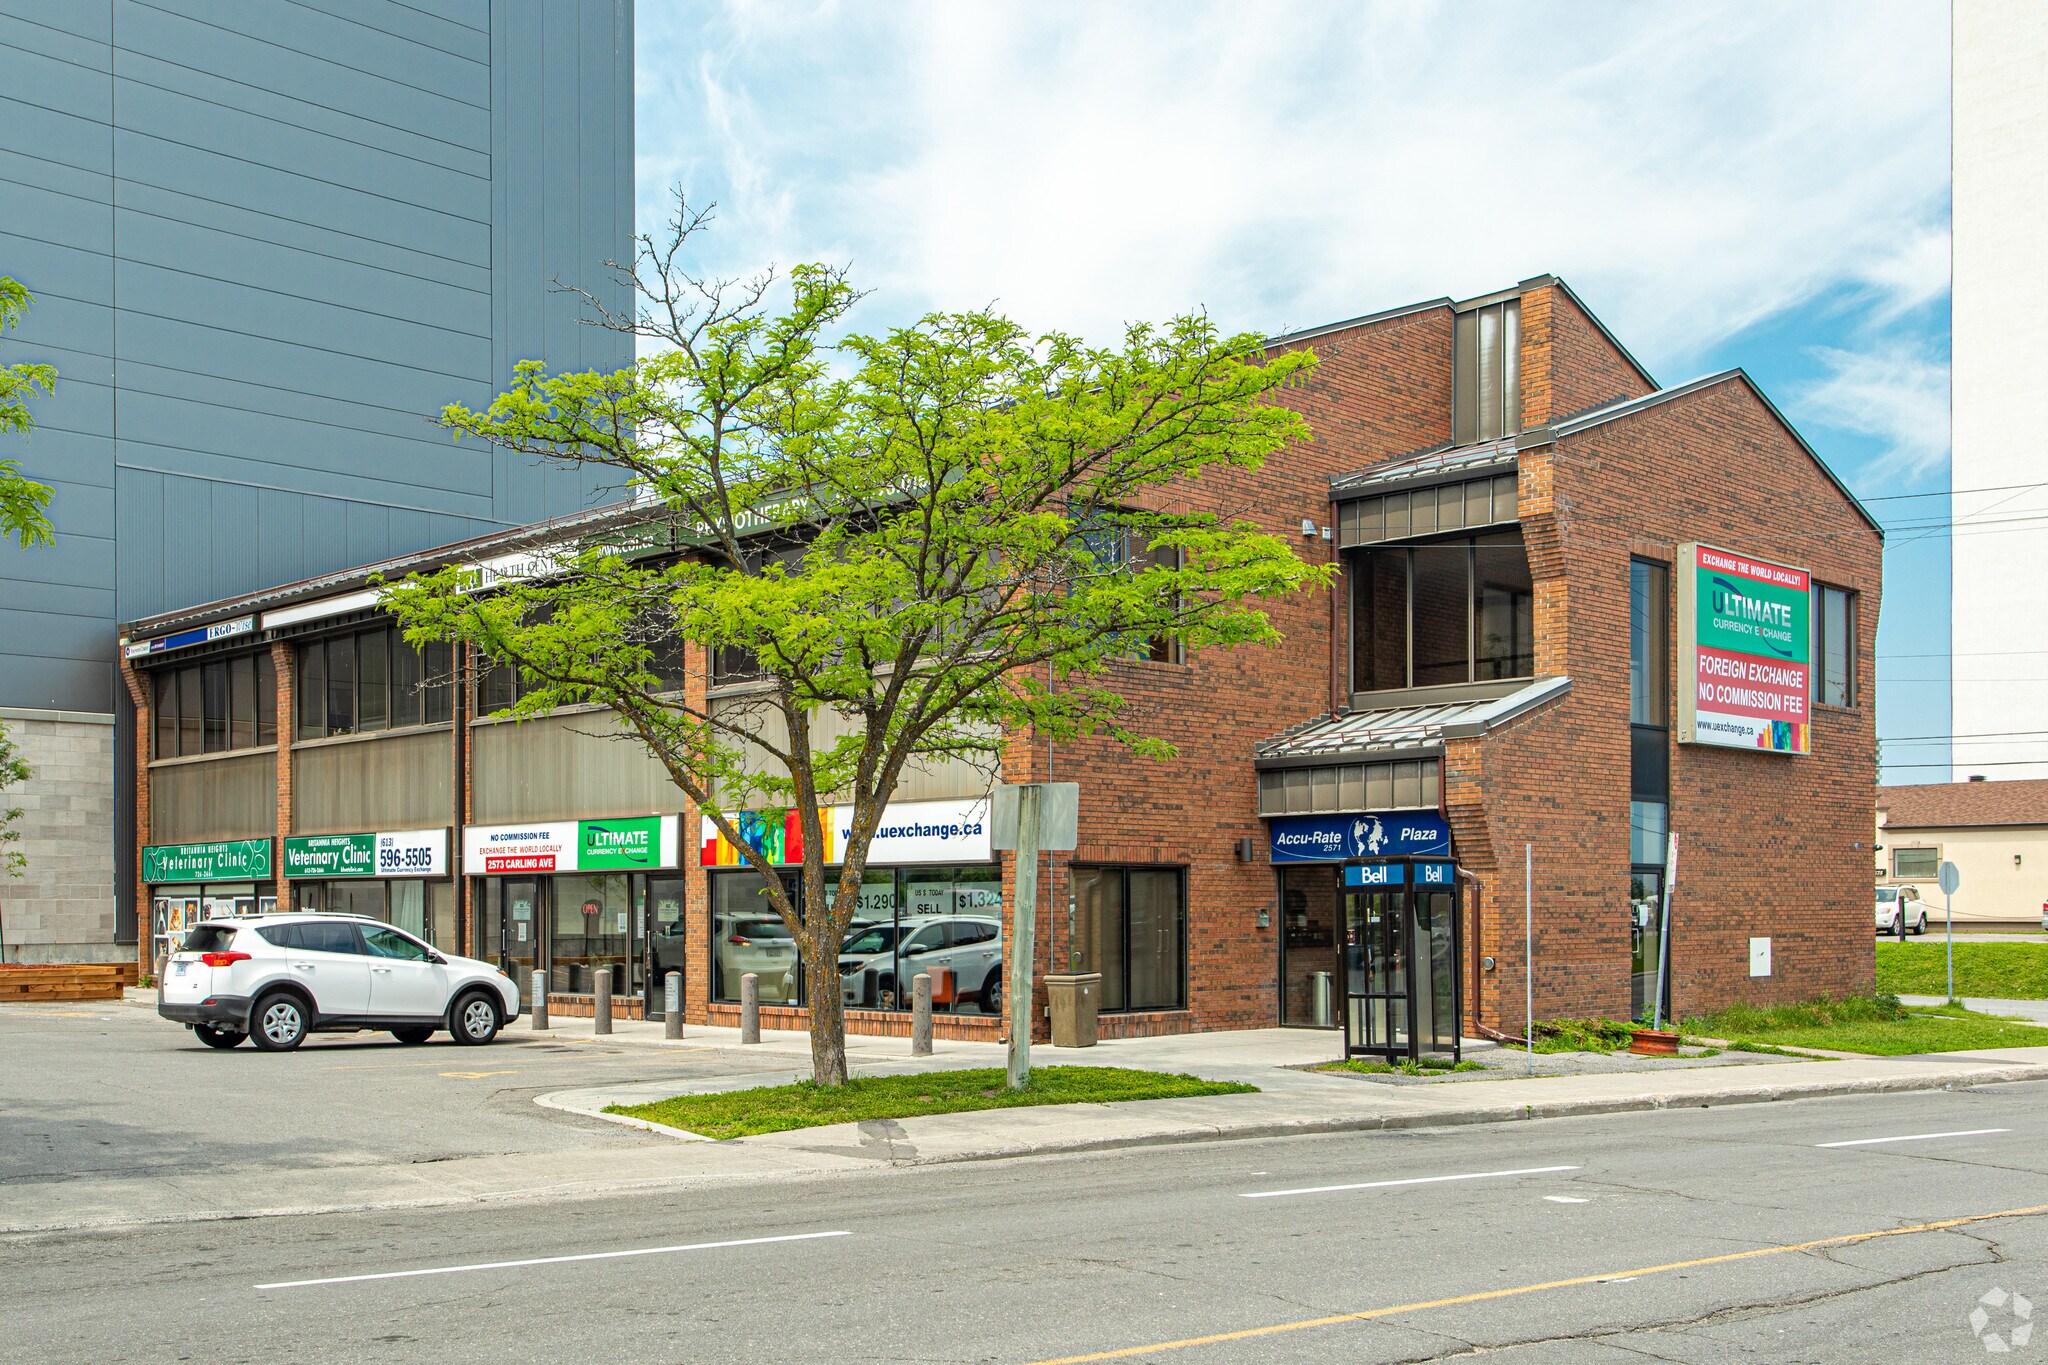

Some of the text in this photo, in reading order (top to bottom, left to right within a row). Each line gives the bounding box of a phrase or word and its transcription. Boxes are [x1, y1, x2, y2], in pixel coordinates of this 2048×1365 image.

[1702, 553, 1800, 586] EXCHANGE THE WORLD LOCALLY!
[1712, 590, 1792, 627] ULTIMATE
[1713, 617, 1792, 642] CURRENCY EXCHANGE
[1699, 655, 1803, 689] FOREIGN EXCHANGE
[1699, 681, 1803, 714] NO COMMISSION FEE
[1697, 720, 1754, 736] www.uexchange.ca
[490, 831, 550, 842] NO COMMISSION FEE
[587, 829, 649, 846] ULTIMATE
[842, 822, 983, 840] w.uexchange.ca
[1277, 828, 1438, 845] Accu-Rate Plaza
[180, 844, 228, 856] BRITANNIA HEIGHTS
[308, 837, 351, 847] BRITANNIA HEIGHTS
[380, 837, 394, 848] (613)
[479, 844, 562, 855] EXCHANGE THE WORLD LOCALLY
[1323, 844, 1341, 852] 2571
[288, 843, 371, 870] Veterinary Clinic
[380, 847, 432, 867] 596-5505
[586, 846, 648, 856] CURRENCY EXCHANGE
[162, 852, 247, 872] Veterinary Clinic
[487, 857, 554, 870] 2573 CARLING AVE
[1361, 866, 1388, 884] Bell
[1425, 865, 1443, 883] Bell
[914, 889, 944, 897] US $ TODAY
[582, 903, 599, 914] OPEN
[857, 894, 895, 910] $1.290
[917, 903, 942, 915] SELL
